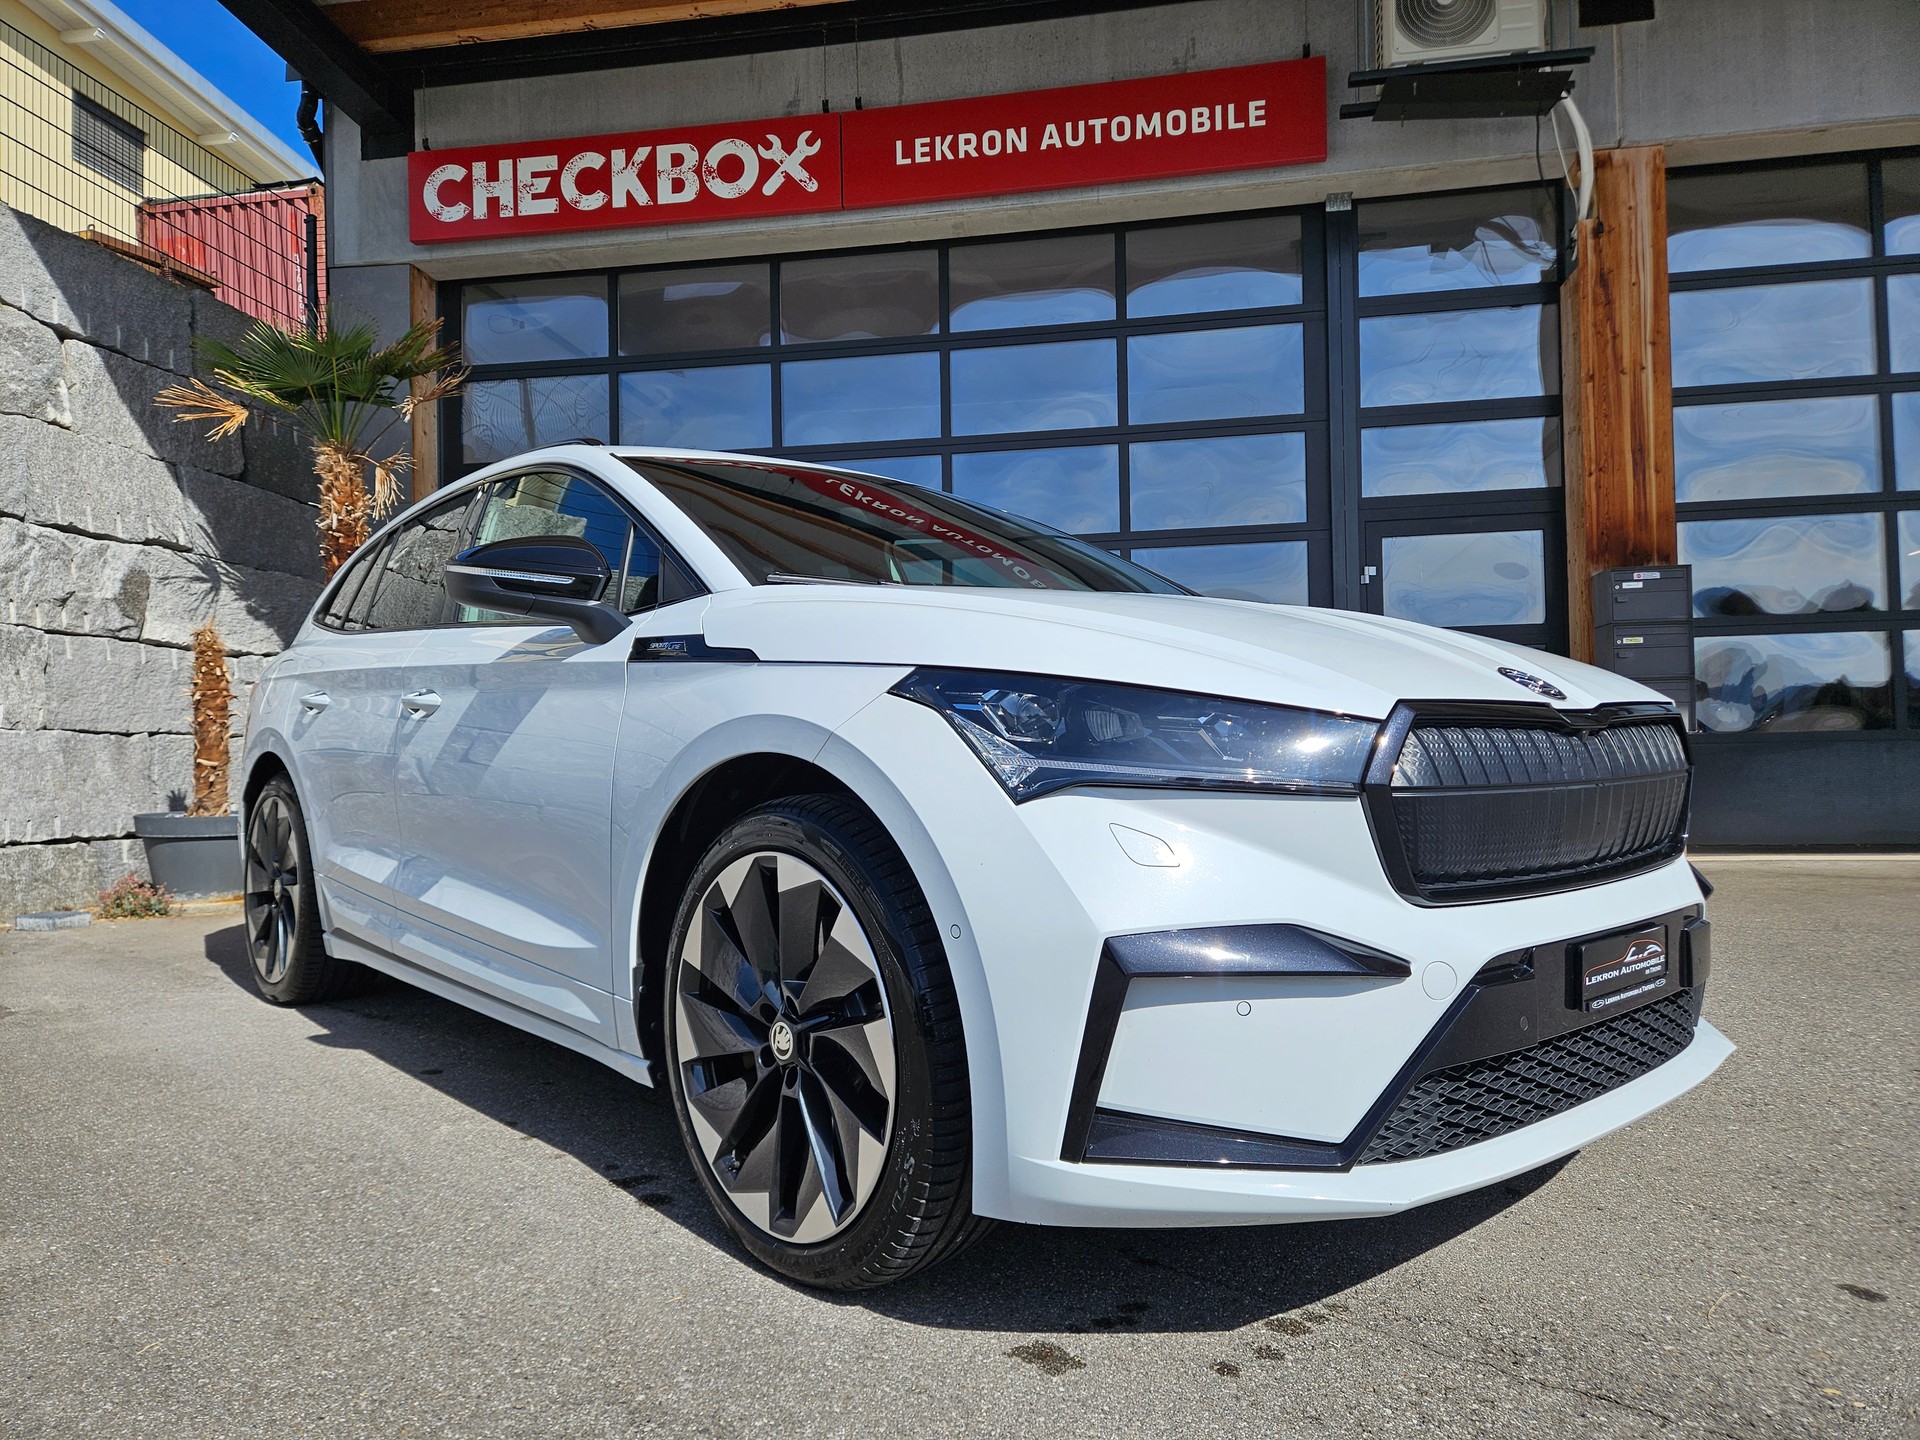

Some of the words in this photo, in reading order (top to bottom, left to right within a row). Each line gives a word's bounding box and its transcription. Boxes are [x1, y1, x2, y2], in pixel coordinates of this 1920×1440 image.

[895, 126, 1027, 165] LEKRON
[1040, 99, 1267, 151] AUTOMOBILE
[422, 130, 822, 223] CHECKBOX
